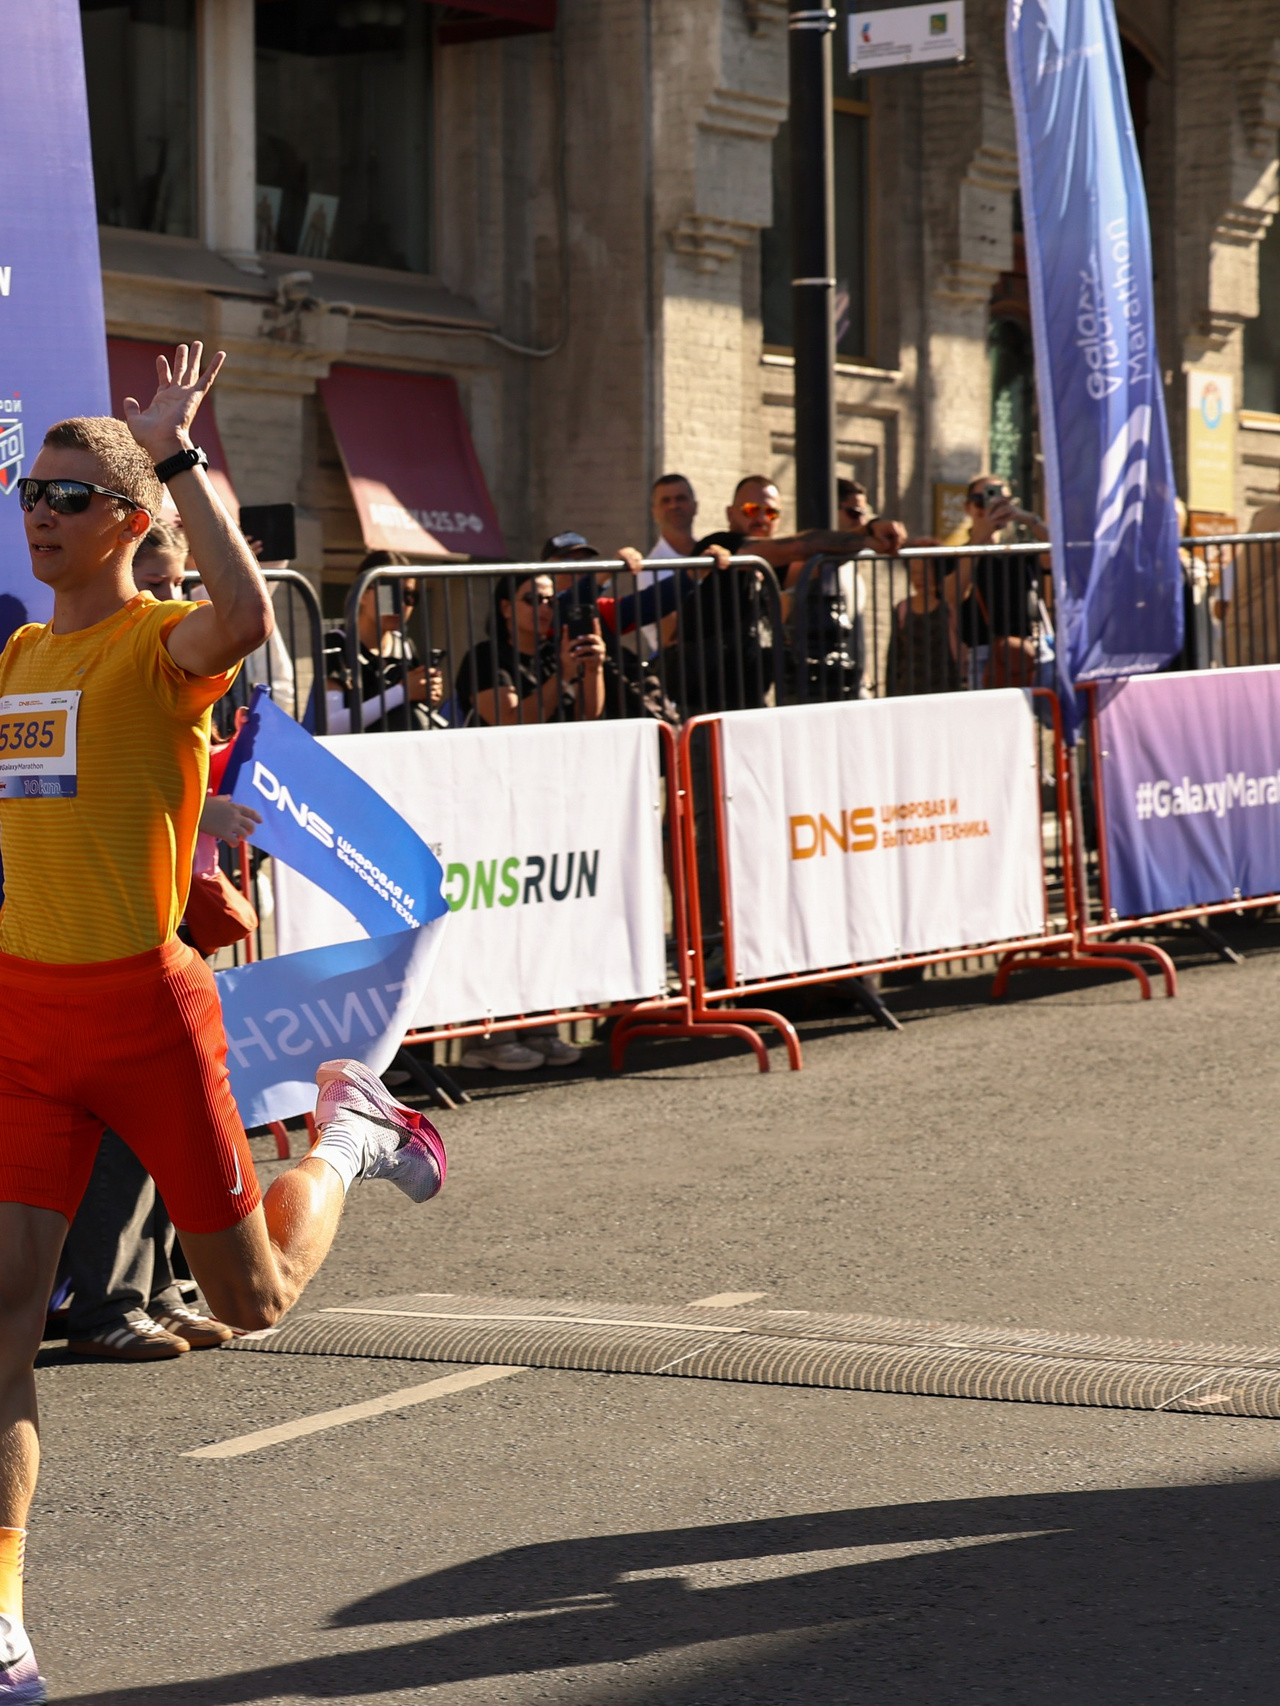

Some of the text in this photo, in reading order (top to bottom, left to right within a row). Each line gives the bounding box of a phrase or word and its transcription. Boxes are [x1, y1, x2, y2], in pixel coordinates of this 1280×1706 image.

[0, 763, 44, 771] #GalaxyMarathon
[24, 778, 61, 795] 10km
[252, 761, 335, 849] DNS
[880, 798, 958, 824] ЦИФРОВАЯ И
[1136, 768, 1280, 820] #GalaxyMara
[789, 807, 878, 861] DNS
[882, 820, 990, 849] БЫТОВАЯ ТЕХНИКА
[336, 848, 389, 901] БЫТОВАЯ
[337, 836, 415, 910] ЦИФРОВАЯ И
[445, 849, 600, 912] DNSRUN
